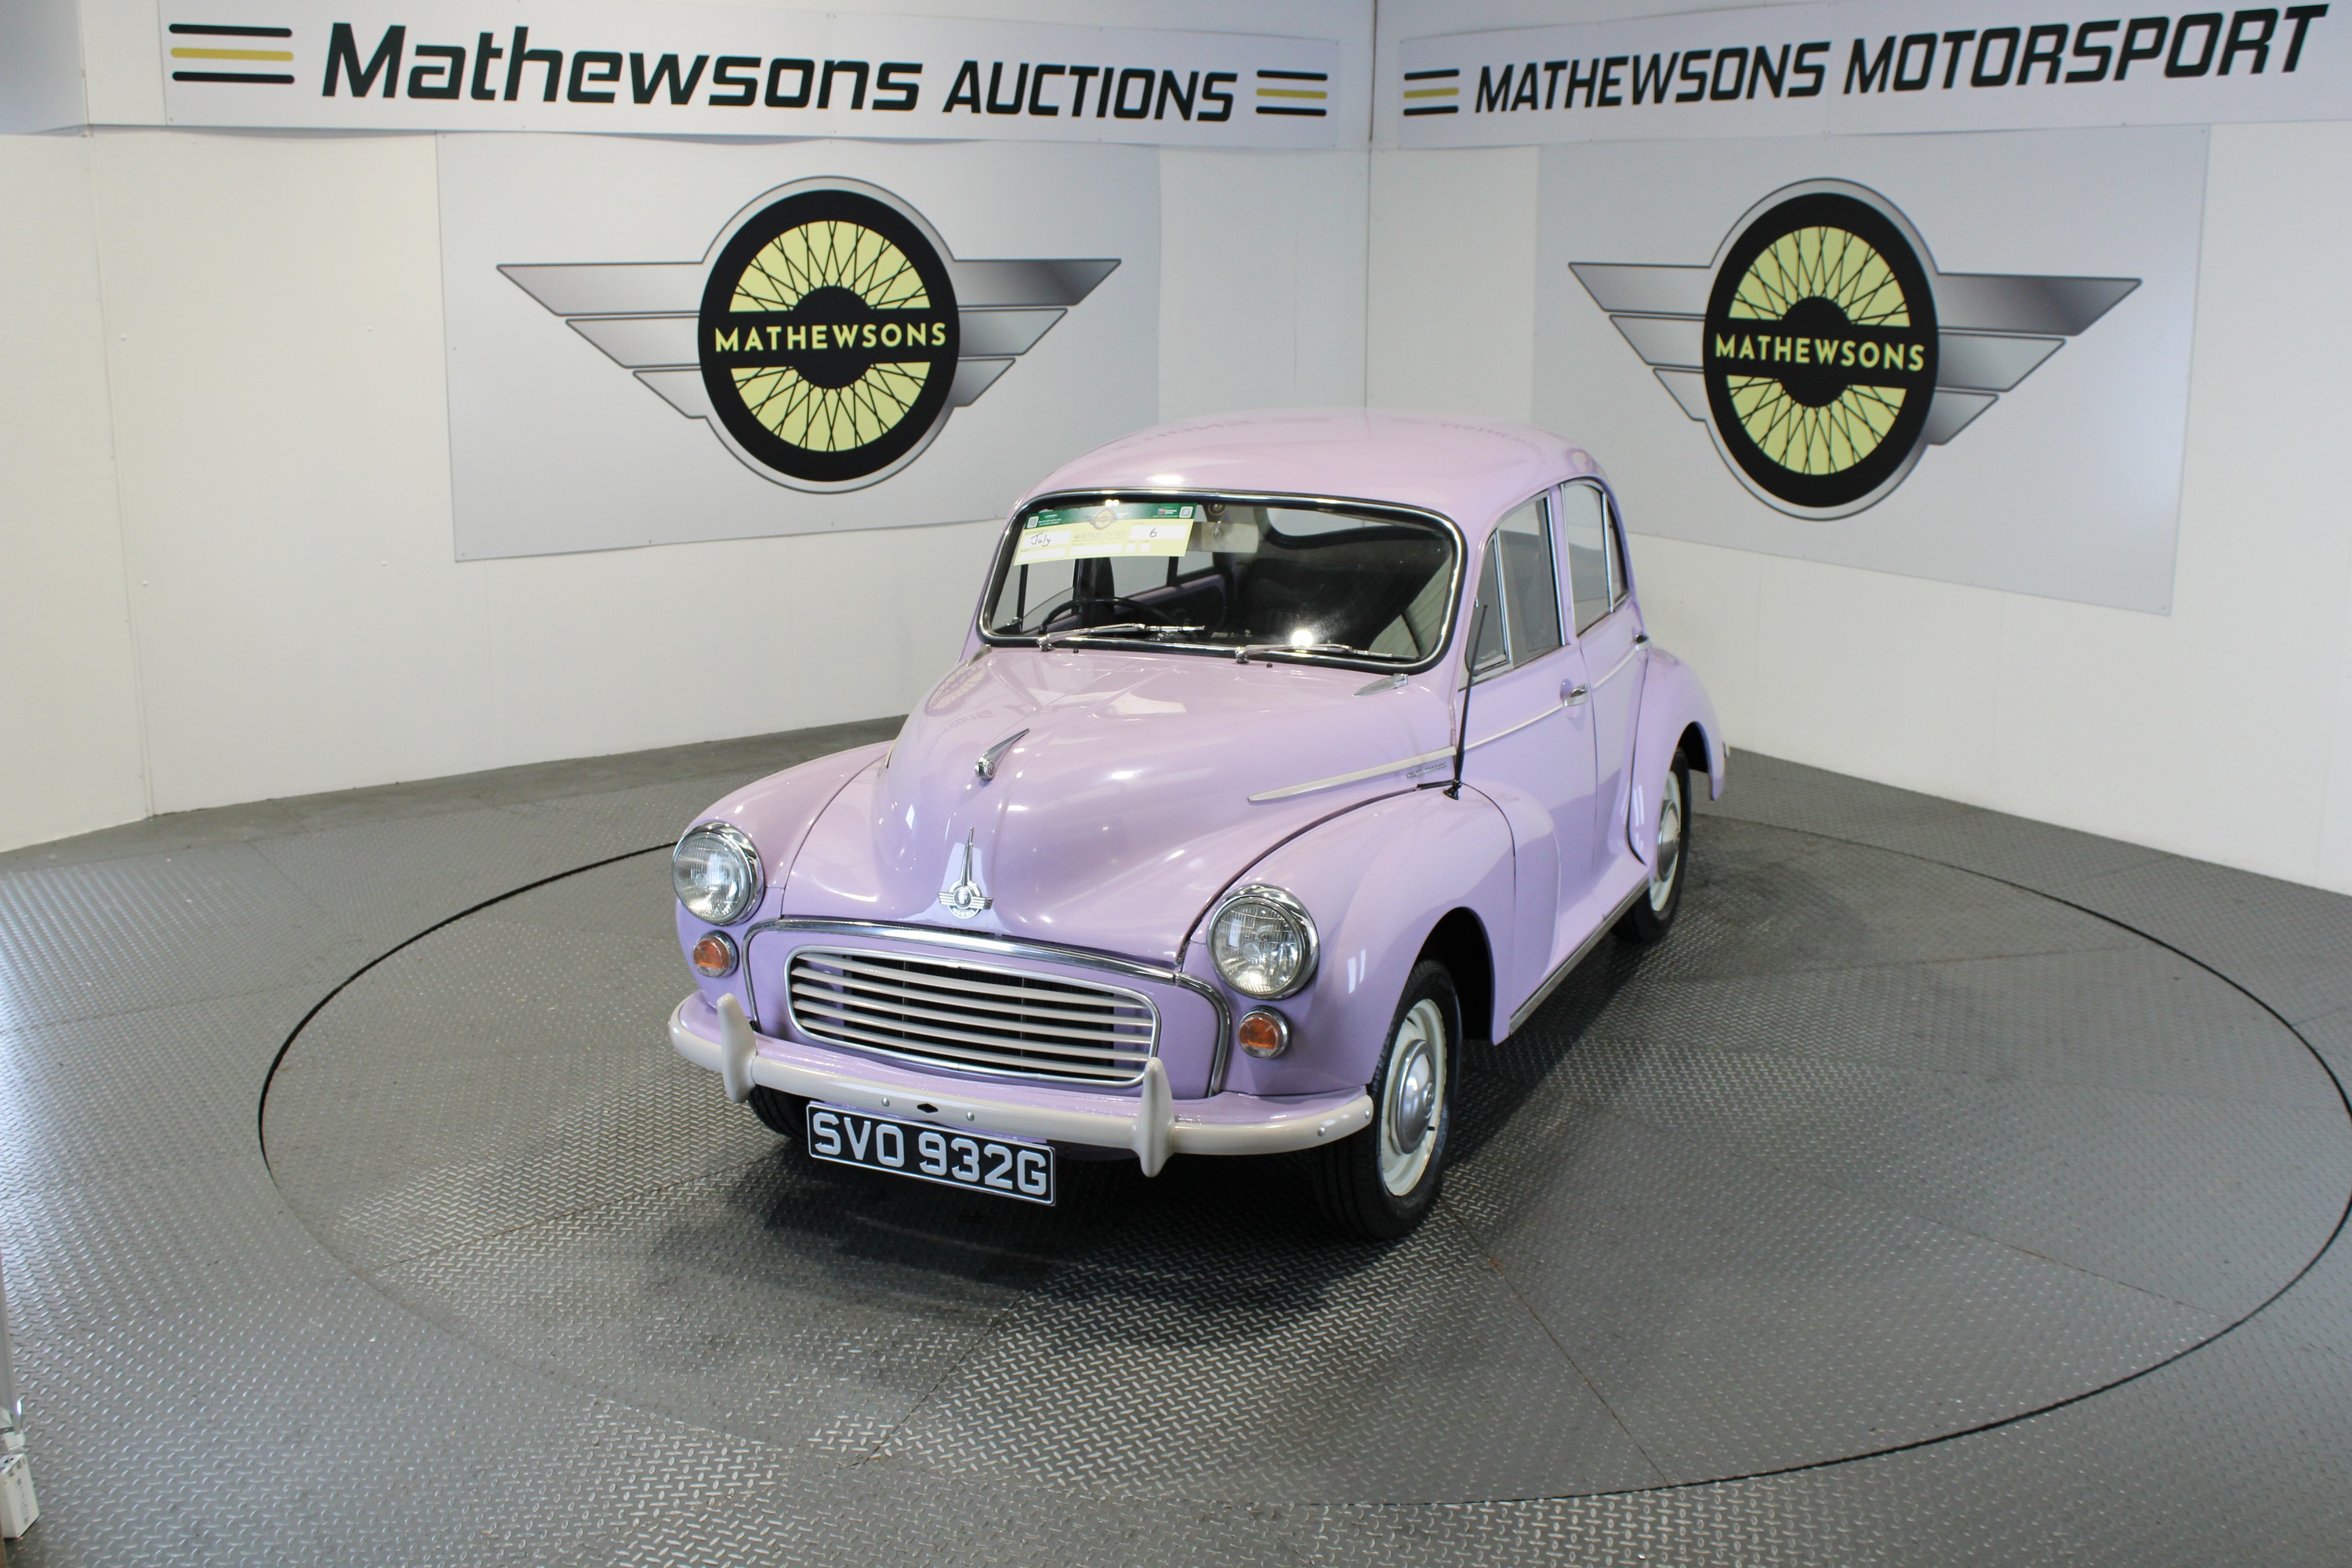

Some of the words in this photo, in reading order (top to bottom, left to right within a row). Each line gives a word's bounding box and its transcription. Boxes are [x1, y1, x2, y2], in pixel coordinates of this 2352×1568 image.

[322, 22, 924, 111] Mathewsons
[942, 60, 1239, 122] AUCTIONS
[1475, 41, 1831, 114] MATHEWSONS
[1843, 3, 2331, 95] MOTORSPORT
[714, 322, 946, 353] MATHEWSONS
[1715, 333, 1926, 372] MATHEWSONS
[1030, 532, 1051, 547] July
[1149, 527, 1157, 538] 6
[812, 1112, 906, 1168] SVO
[918, 1131, 1047, 1196] 932G
